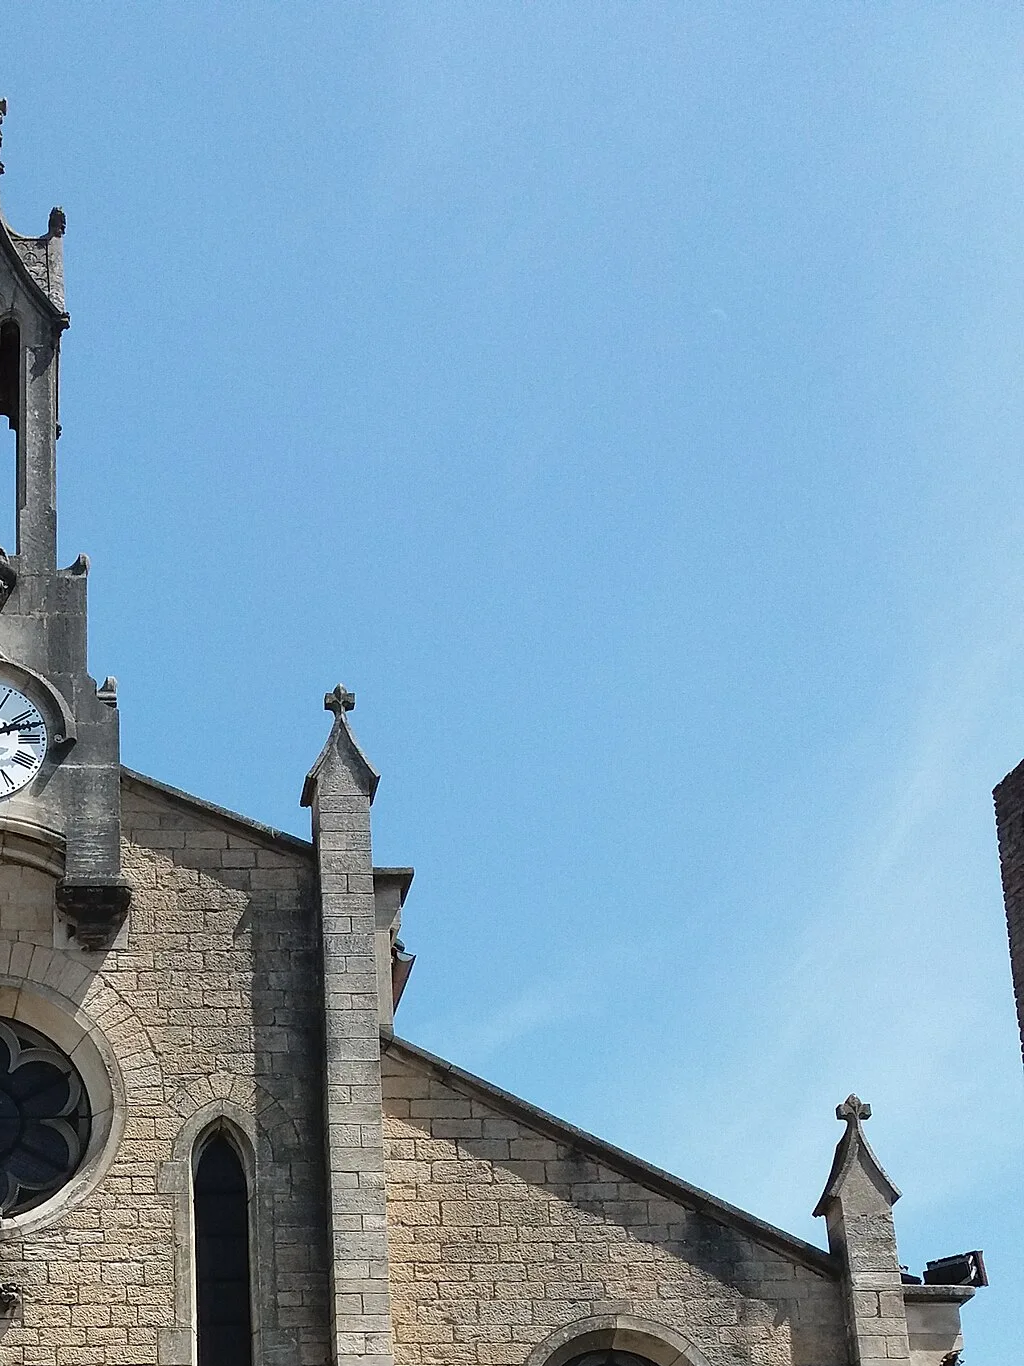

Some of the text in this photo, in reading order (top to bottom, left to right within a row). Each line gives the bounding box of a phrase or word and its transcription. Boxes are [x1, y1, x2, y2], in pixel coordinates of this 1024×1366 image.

[17, 734, 40, 744] III
[11, 750, 37, 770] IIII
[0, 769, 14, 787] V
